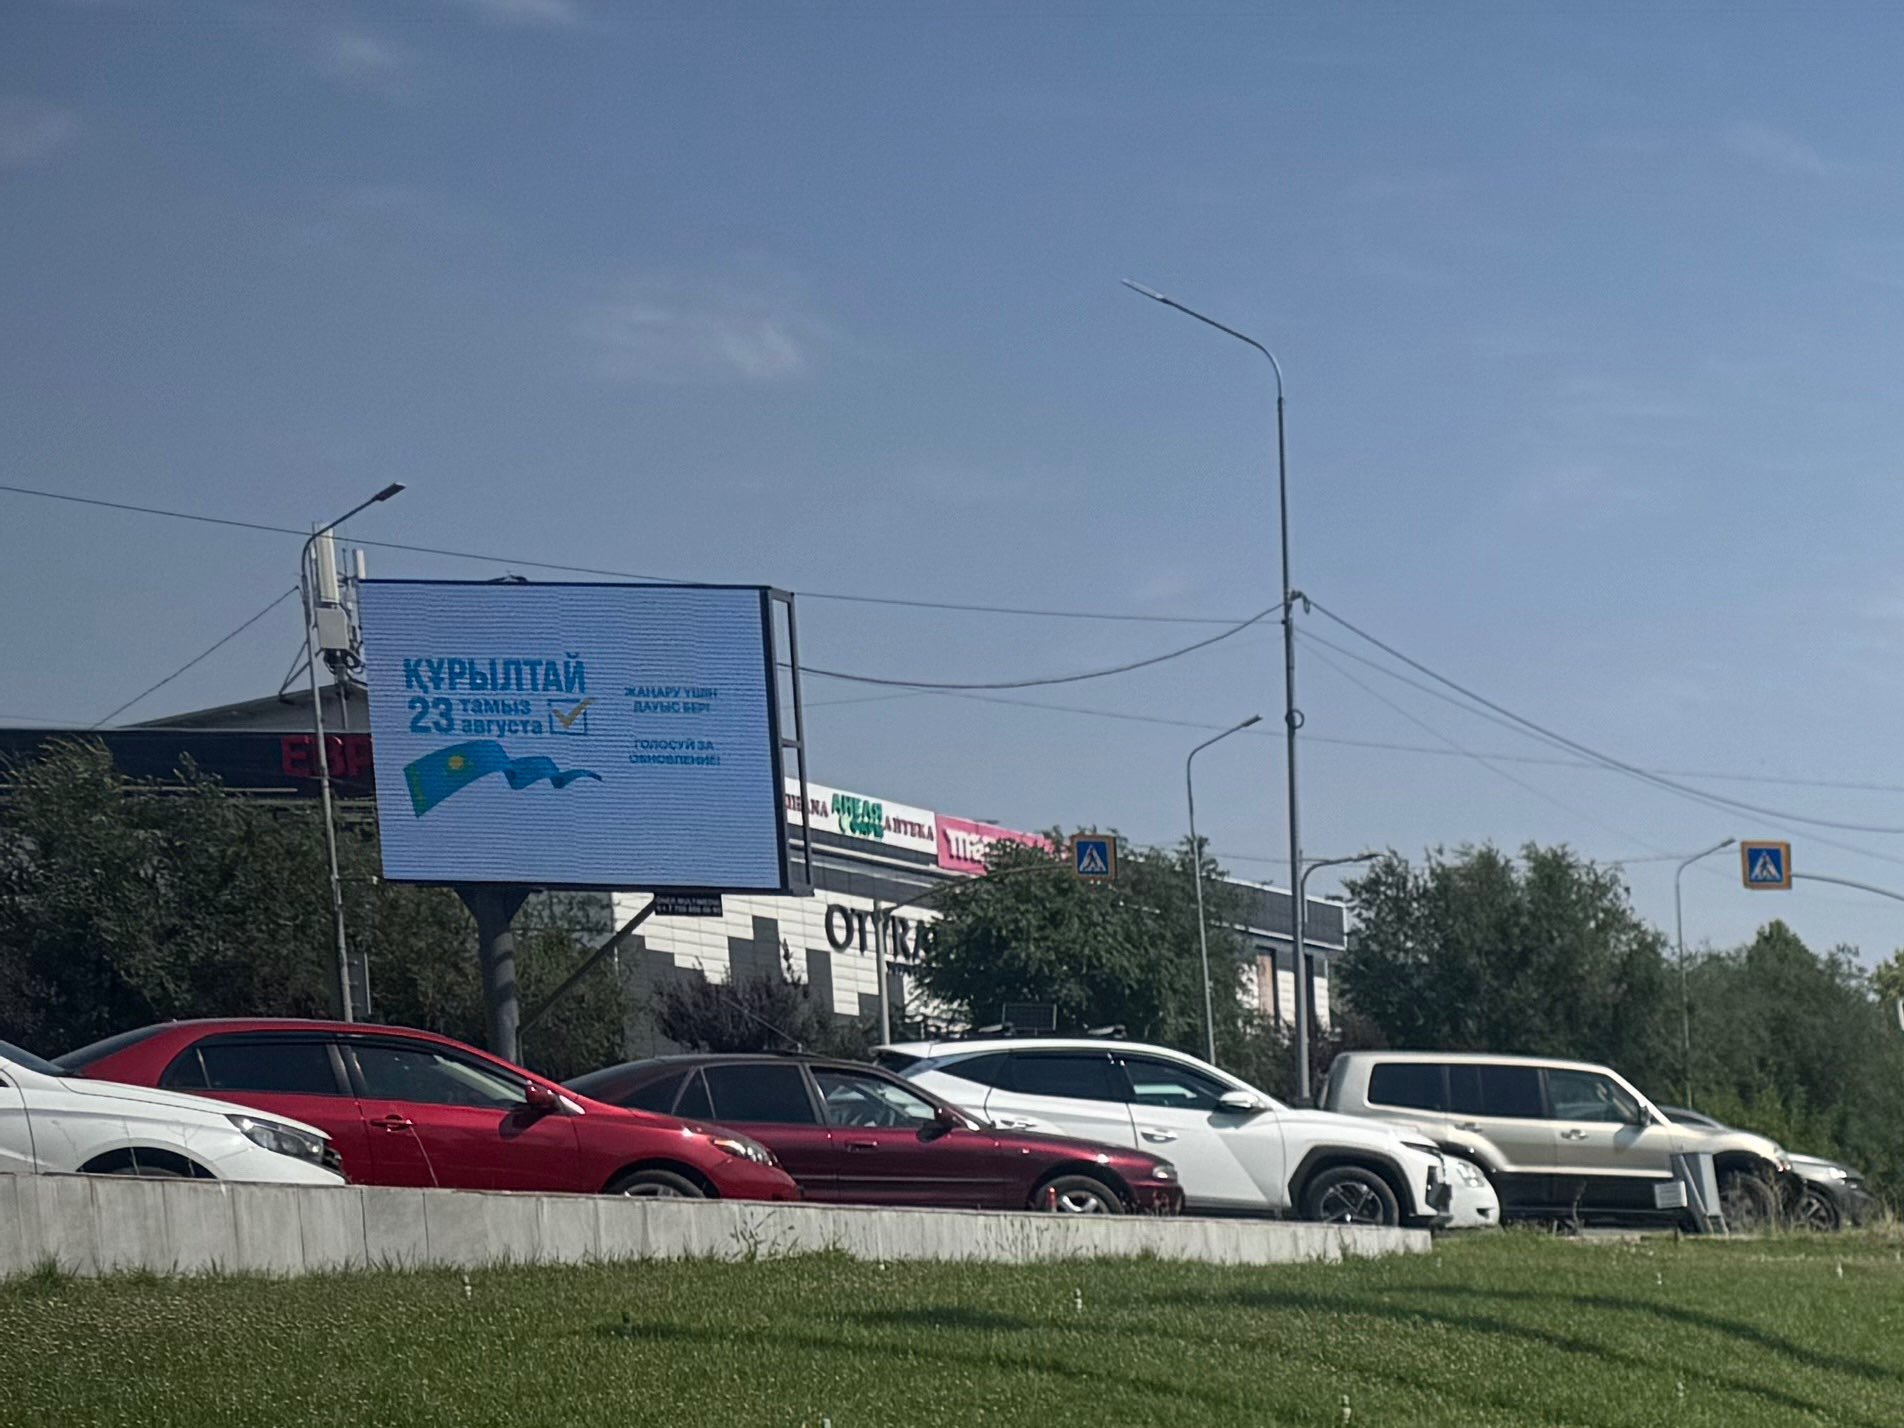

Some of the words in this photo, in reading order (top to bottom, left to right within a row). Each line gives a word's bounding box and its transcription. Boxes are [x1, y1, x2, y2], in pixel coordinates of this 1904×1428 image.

[403, 652, 586, 694] ҚҰРЫЛТАЙ
[408, 696, 455, 734] 23
[460, 699, 532, 716] тамыз
[461, 719, 543, 738] августа
[634, 738, 695, 751] ГОЛОСУЙ
[697, 740, 715, 751] ЗА
[884, 815, 934, 842] АПТЕКА
